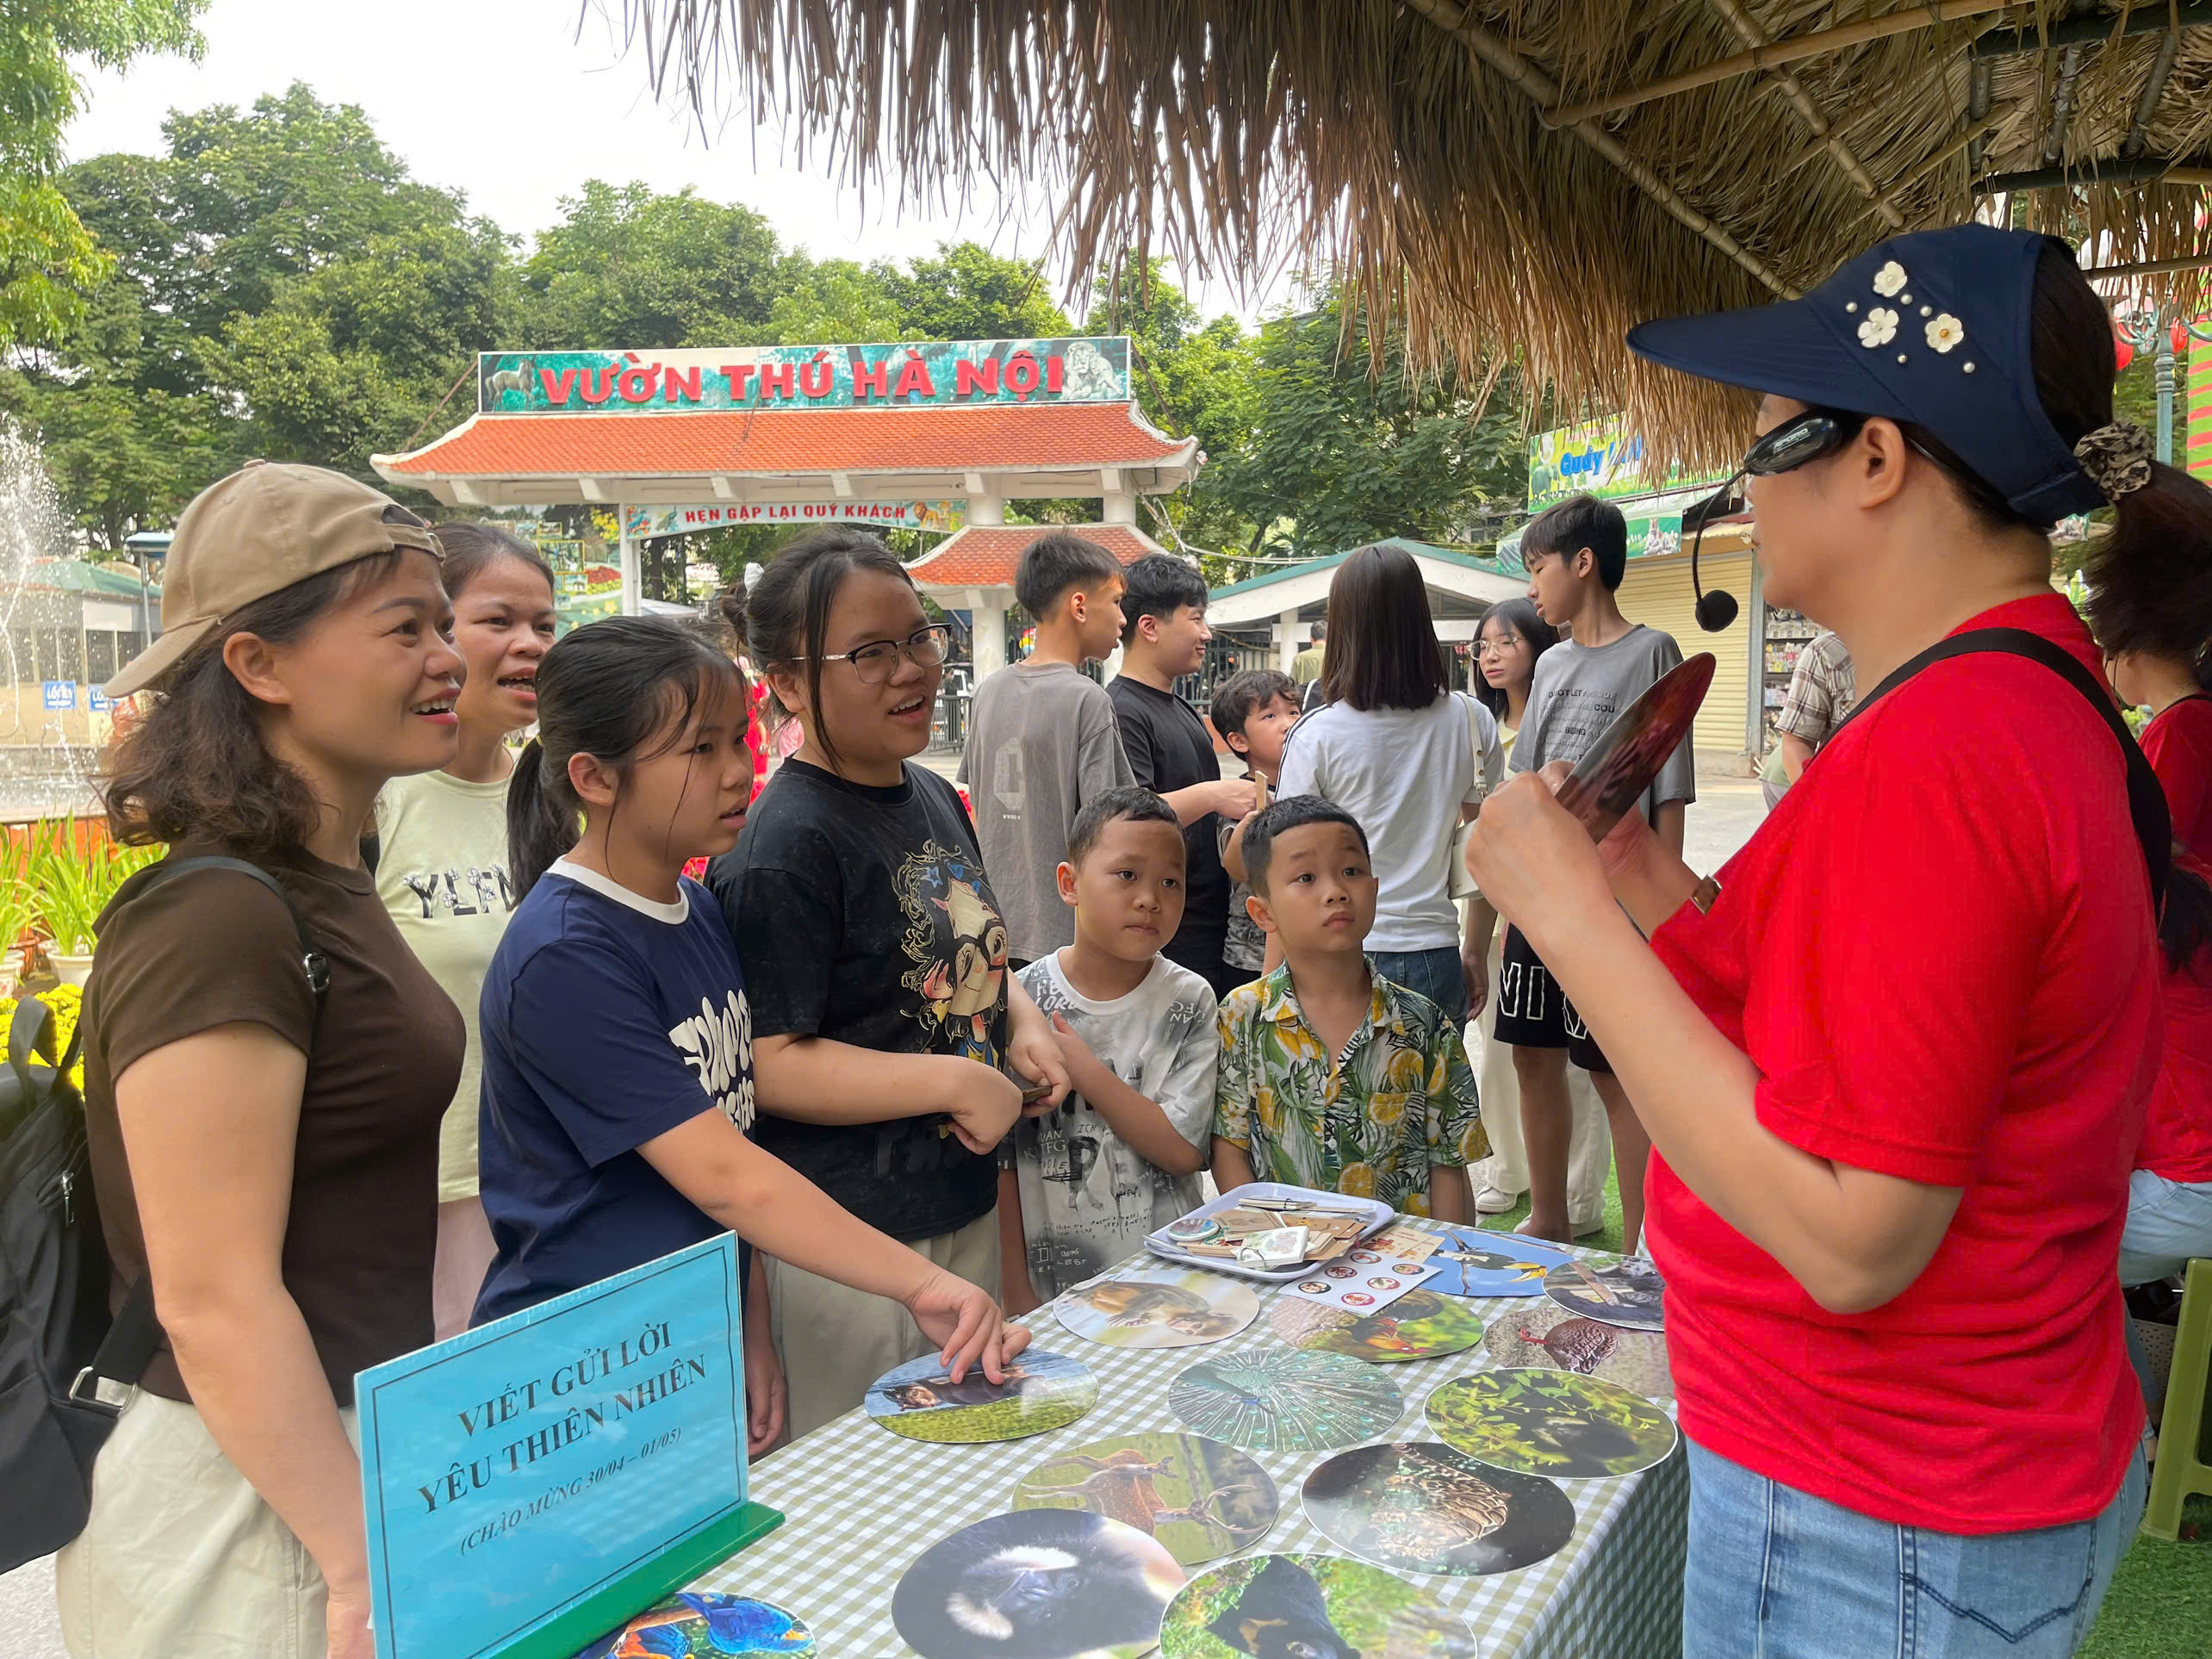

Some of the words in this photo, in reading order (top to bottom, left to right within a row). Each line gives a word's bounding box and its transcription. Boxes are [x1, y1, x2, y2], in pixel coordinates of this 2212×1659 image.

[539, 352, 701, 405] VƯỜN
[720, 351, 834, 400] THÚ
[853, 350, 936, 397] HÀ
[957, 350, 1063, 402] NỘI
[685, 509, 720, 525] HẸN
[727, 505, 762, 522] GẶP
[769, 506, 797, 520] LẠI
[804, 503, 838, 518] QUÝ
[845, 504, 906, 519] KHÁCH
[417, 1456, 492, 1515] YÊU
[501, 1401, 606, 1474] THIÊN
[613, 1353, 706, 1421] NHIÊN
[457, 1382, 541, 1438] VIẾT
[550, 1345, 611, 1397] GỬI
[620, 1320, 673, 1369] LỜI
[461, 1509, 522, 1556] (CHÀO
[525, 1476, 583, 1519] MỪNG
[586, 1454, 626, 1488] 30/04
[640, 1426, 681, 1460] 01/05)
